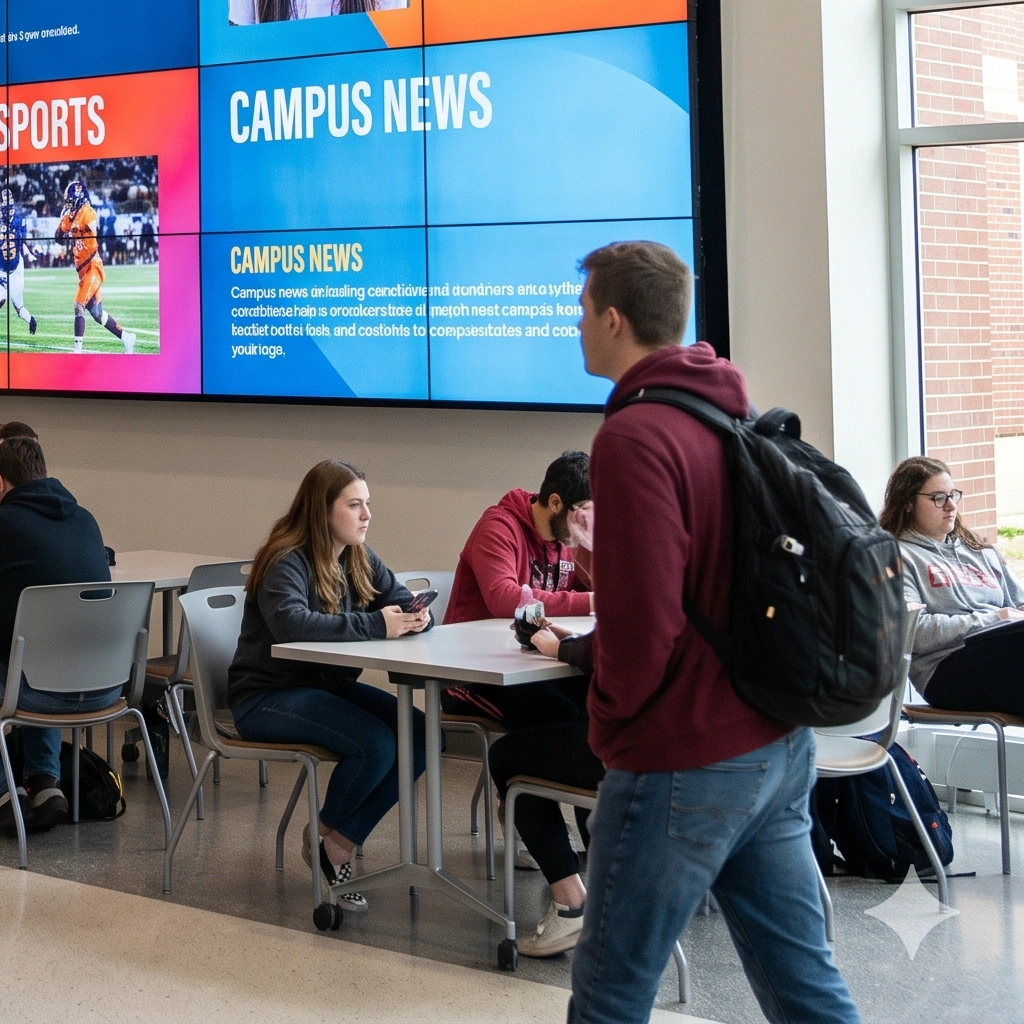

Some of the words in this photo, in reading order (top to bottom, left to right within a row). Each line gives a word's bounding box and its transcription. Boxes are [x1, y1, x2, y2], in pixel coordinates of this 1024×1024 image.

[230, 80, 373, 144] CAMPUS
[383, 70, 493, 134] NEWS
[230, 244, 305, 274] CAMPUS
[309, 242, 364, 273] NEWS
[231, 285, 276, 302] Campus
[278, 288, 309, 298] news
[333, 323, 356, 336] and
[413, 323, 426, 337] to
[524, 322, 550, 337] and
